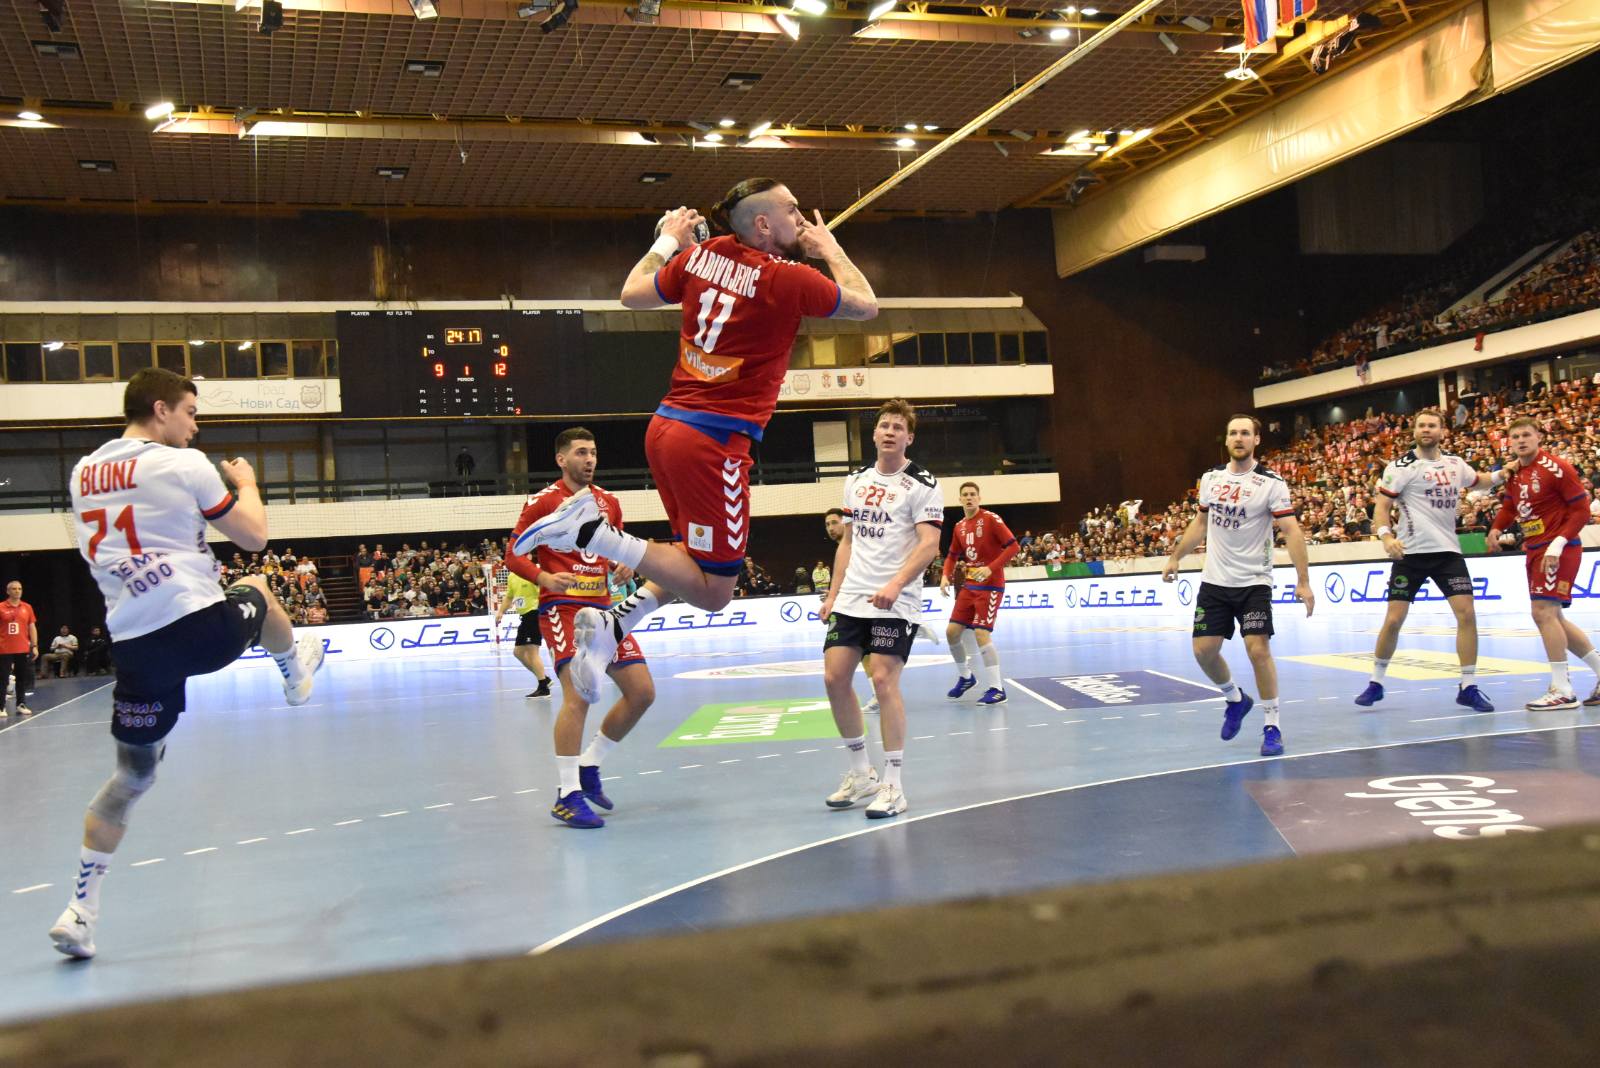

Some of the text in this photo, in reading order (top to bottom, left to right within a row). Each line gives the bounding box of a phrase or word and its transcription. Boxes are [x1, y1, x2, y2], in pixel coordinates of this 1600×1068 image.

[694, 287, 737, 353] 17
[447, 330, 480, 343] 24:17
[500, 345, 508, 357] 0
[434, 363, 444, 377] 9
[464, 366, 470, 376] 1
[494, 363, 506, 376] 12
[240, 397, 300, 409] Нови Сад
[80, 458, 138, 497] BLONZ
[1434, 470, 1451, 486] 11
[865, 485, 886, 506] 23
[1218, 484, 1241, 503] 24
[1431, 499, 1456, 508] 1000
[853, 509, 893, 523] REMA
[81, 504, 142, 562] 71
[856, 525, 885, 538] 1000
[1080, 584, 1163, 608] Lasta
